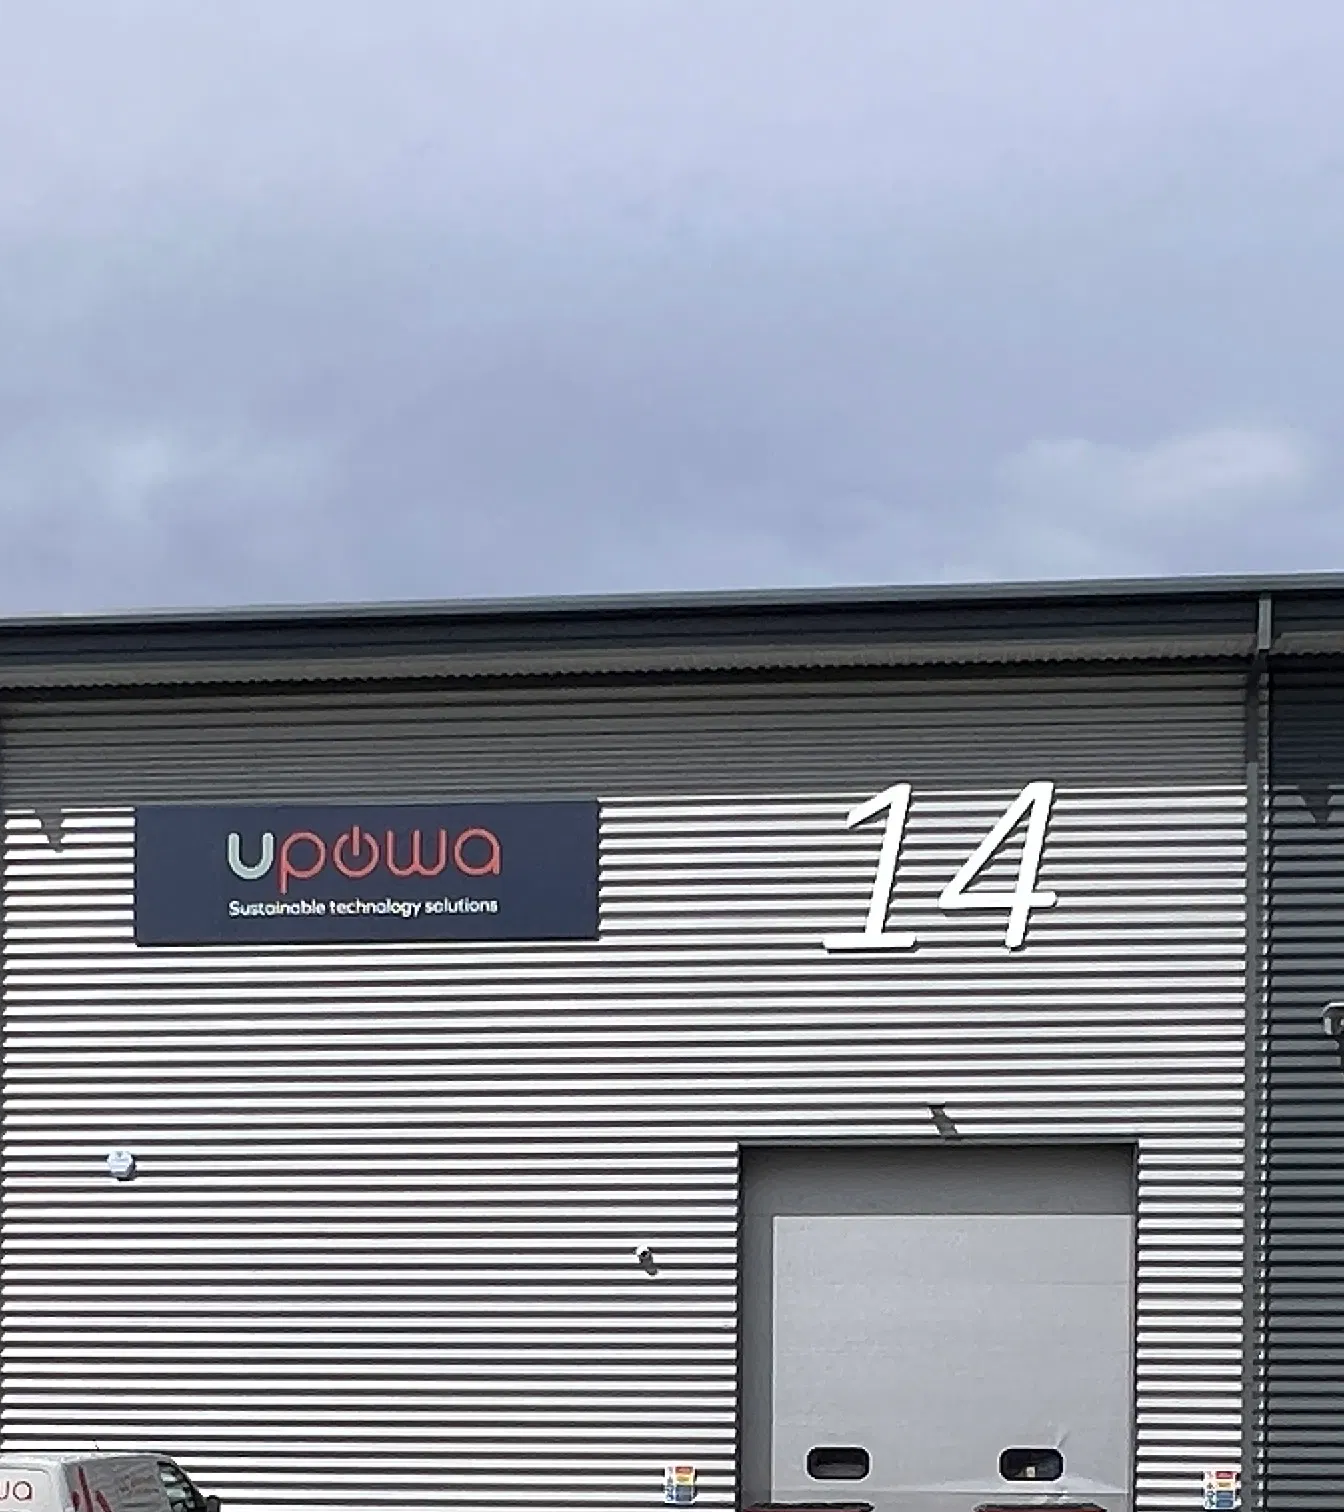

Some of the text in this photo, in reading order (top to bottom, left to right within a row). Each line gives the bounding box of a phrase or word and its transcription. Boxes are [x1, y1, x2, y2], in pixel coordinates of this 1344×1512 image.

[227, 825, 502, 895] upowa
[822, 780, 1058, 949] 14
[228, 898, 499, 918] Sustainable technology solutions
